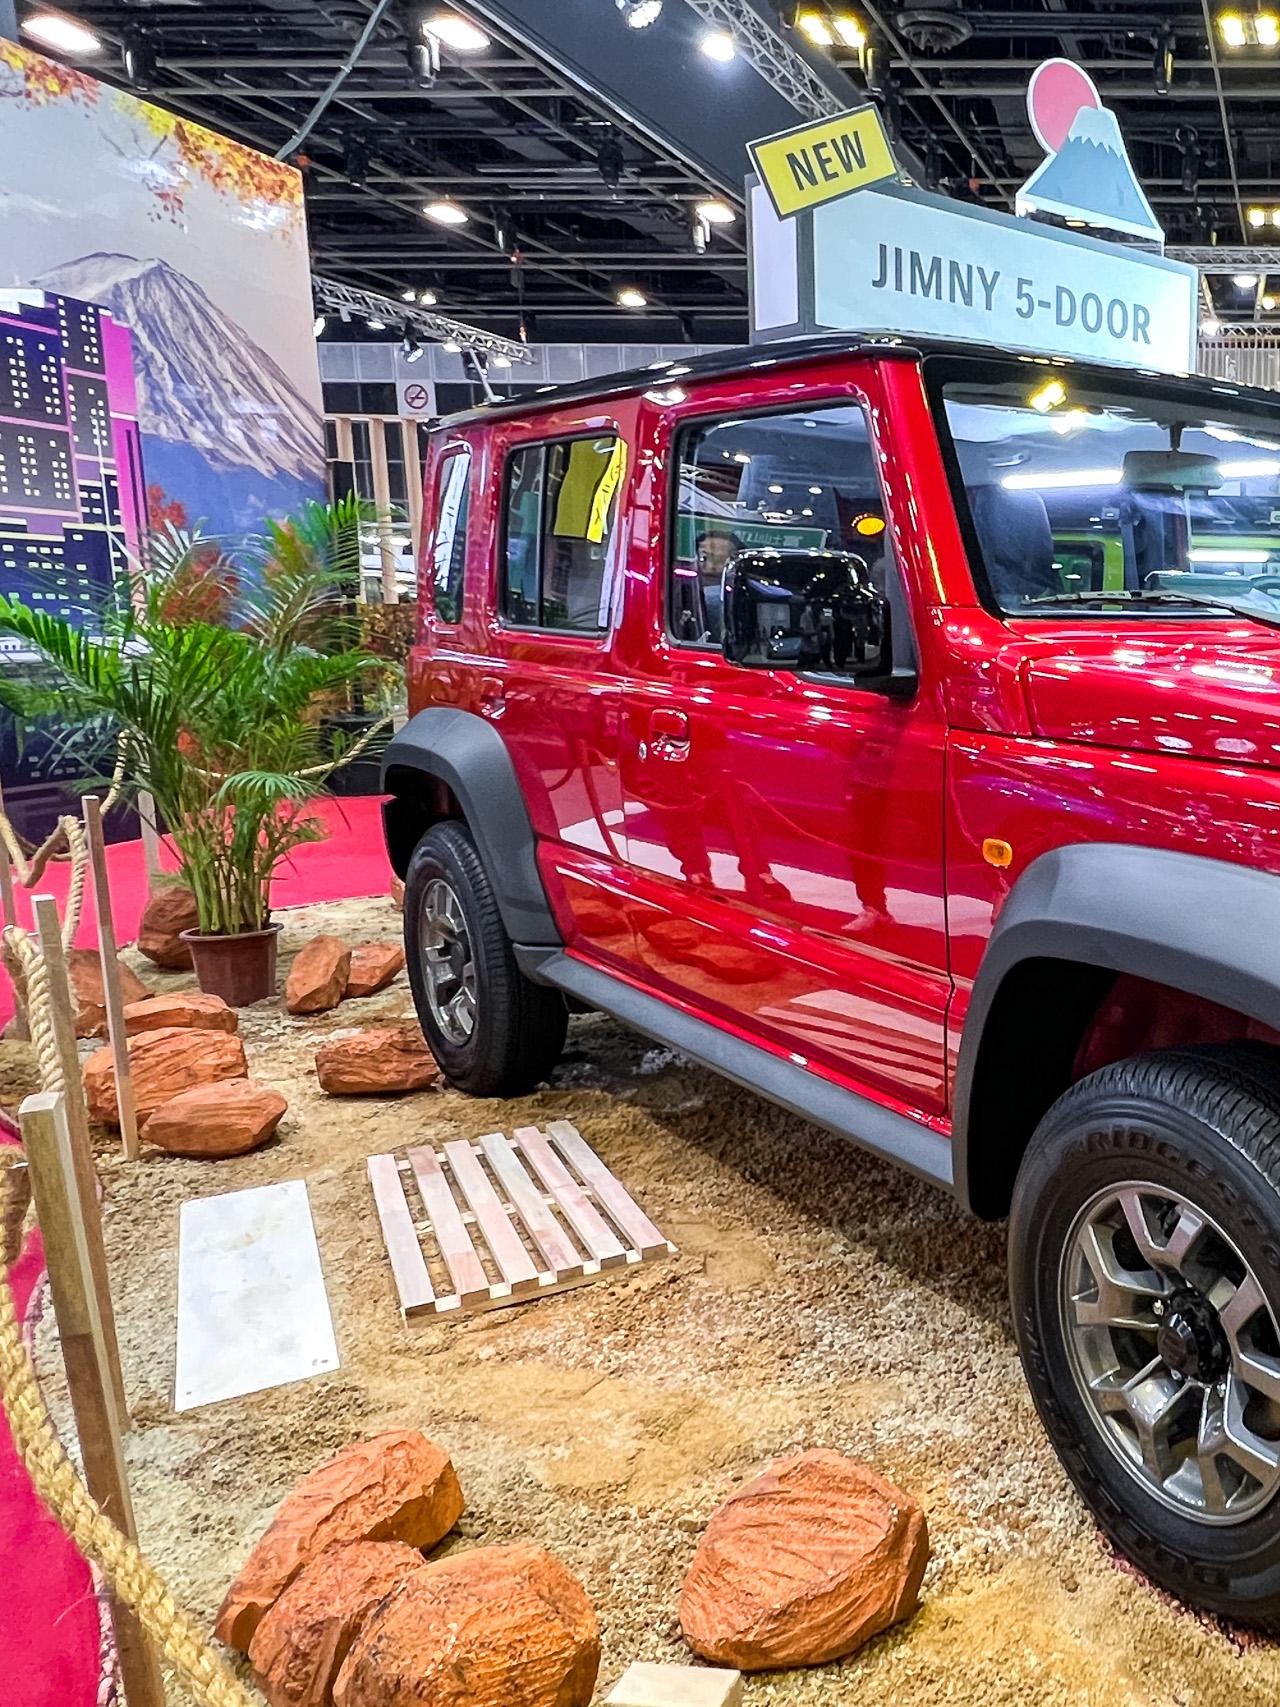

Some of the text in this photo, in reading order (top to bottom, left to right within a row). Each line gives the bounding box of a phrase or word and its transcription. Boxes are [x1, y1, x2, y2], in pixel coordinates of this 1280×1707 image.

[786, 131, 867, 191] NEW
[872, 244, 1151, 344] JIMNY 5-DOOR
